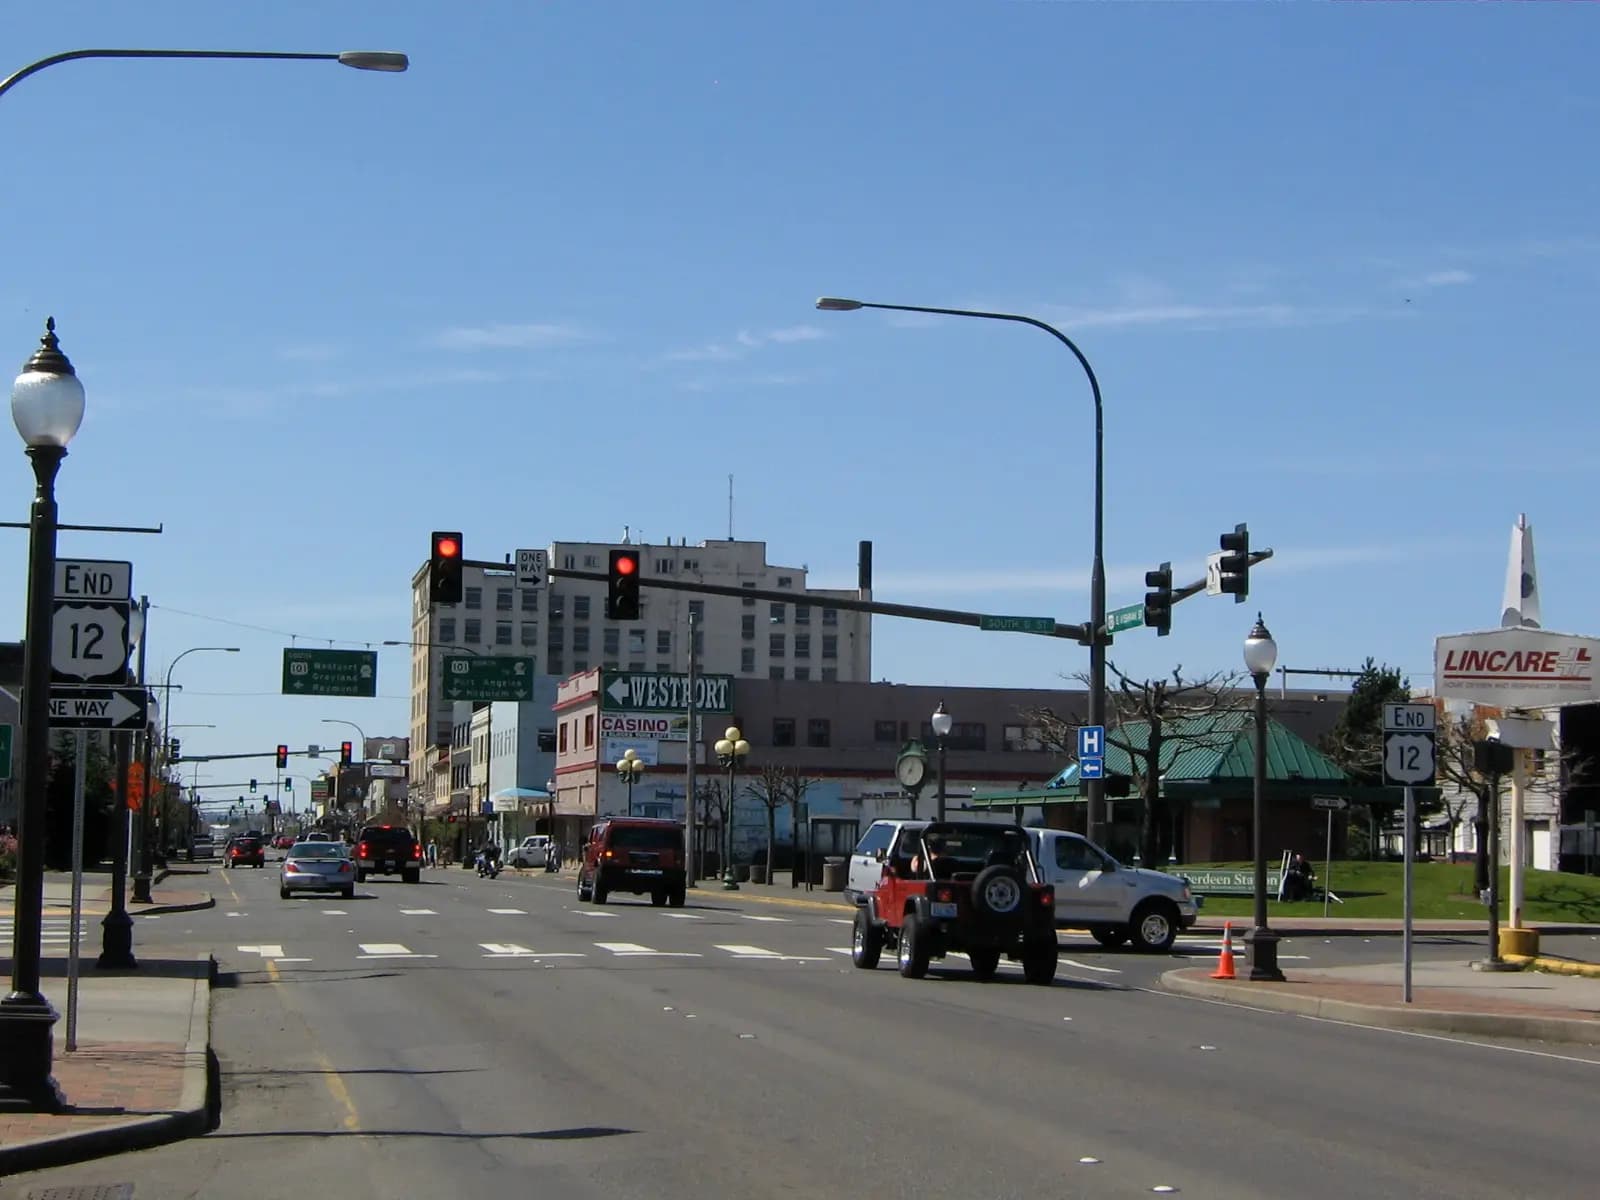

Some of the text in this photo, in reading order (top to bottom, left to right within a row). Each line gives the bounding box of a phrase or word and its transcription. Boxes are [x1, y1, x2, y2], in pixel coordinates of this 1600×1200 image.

[521, 552, 542, 562] ONE
[520, 563, 543, 573] WAY
[65, 565, 113, 595] END
[70, 623, 104, 660] 12
[1444, 650, 1560, 673] LINCARE
[48, 701, 109, 716] NE WAY
[1394, 707, 1425, 727] END
[601, 718, 668, 732] CASINO
[1083, 731, 1099, 753] H
[1399, 746, 1420, 771] 12
[1234, 873, 1278, 886] Staon
